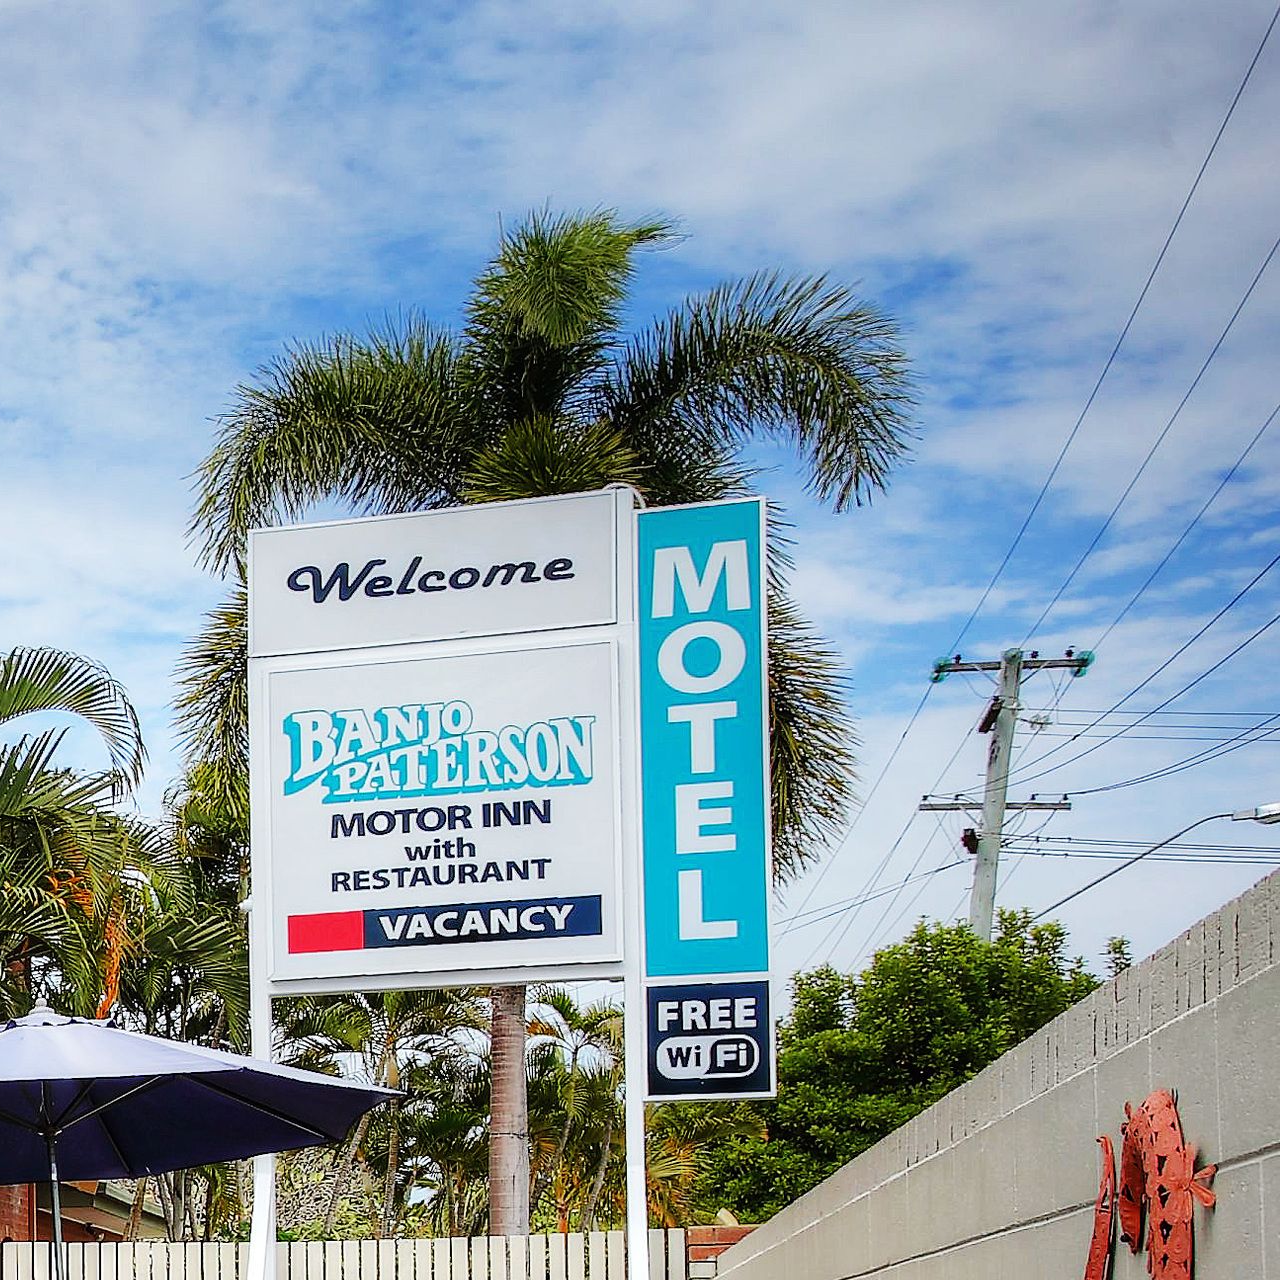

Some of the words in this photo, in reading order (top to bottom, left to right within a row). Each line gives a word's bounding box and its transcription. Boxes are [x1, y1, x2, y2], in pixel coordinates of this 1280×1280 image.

[287, 555, 575, 603] Welcome
[283, 700, 473, 795] BANJO
[651, 540, 751, 941] MOTEL
[322, 716, 596, 804] PATERSON
[331, 805, 472, 838] MOTOR
[482, 800, 551, 828] INN
[404, 837, 476, 860] with
[332, 859, 551, 892] RESTAURANT
[378, 904, 574, 940] VACANCY
[658, 997, 757, 1032] FREE
